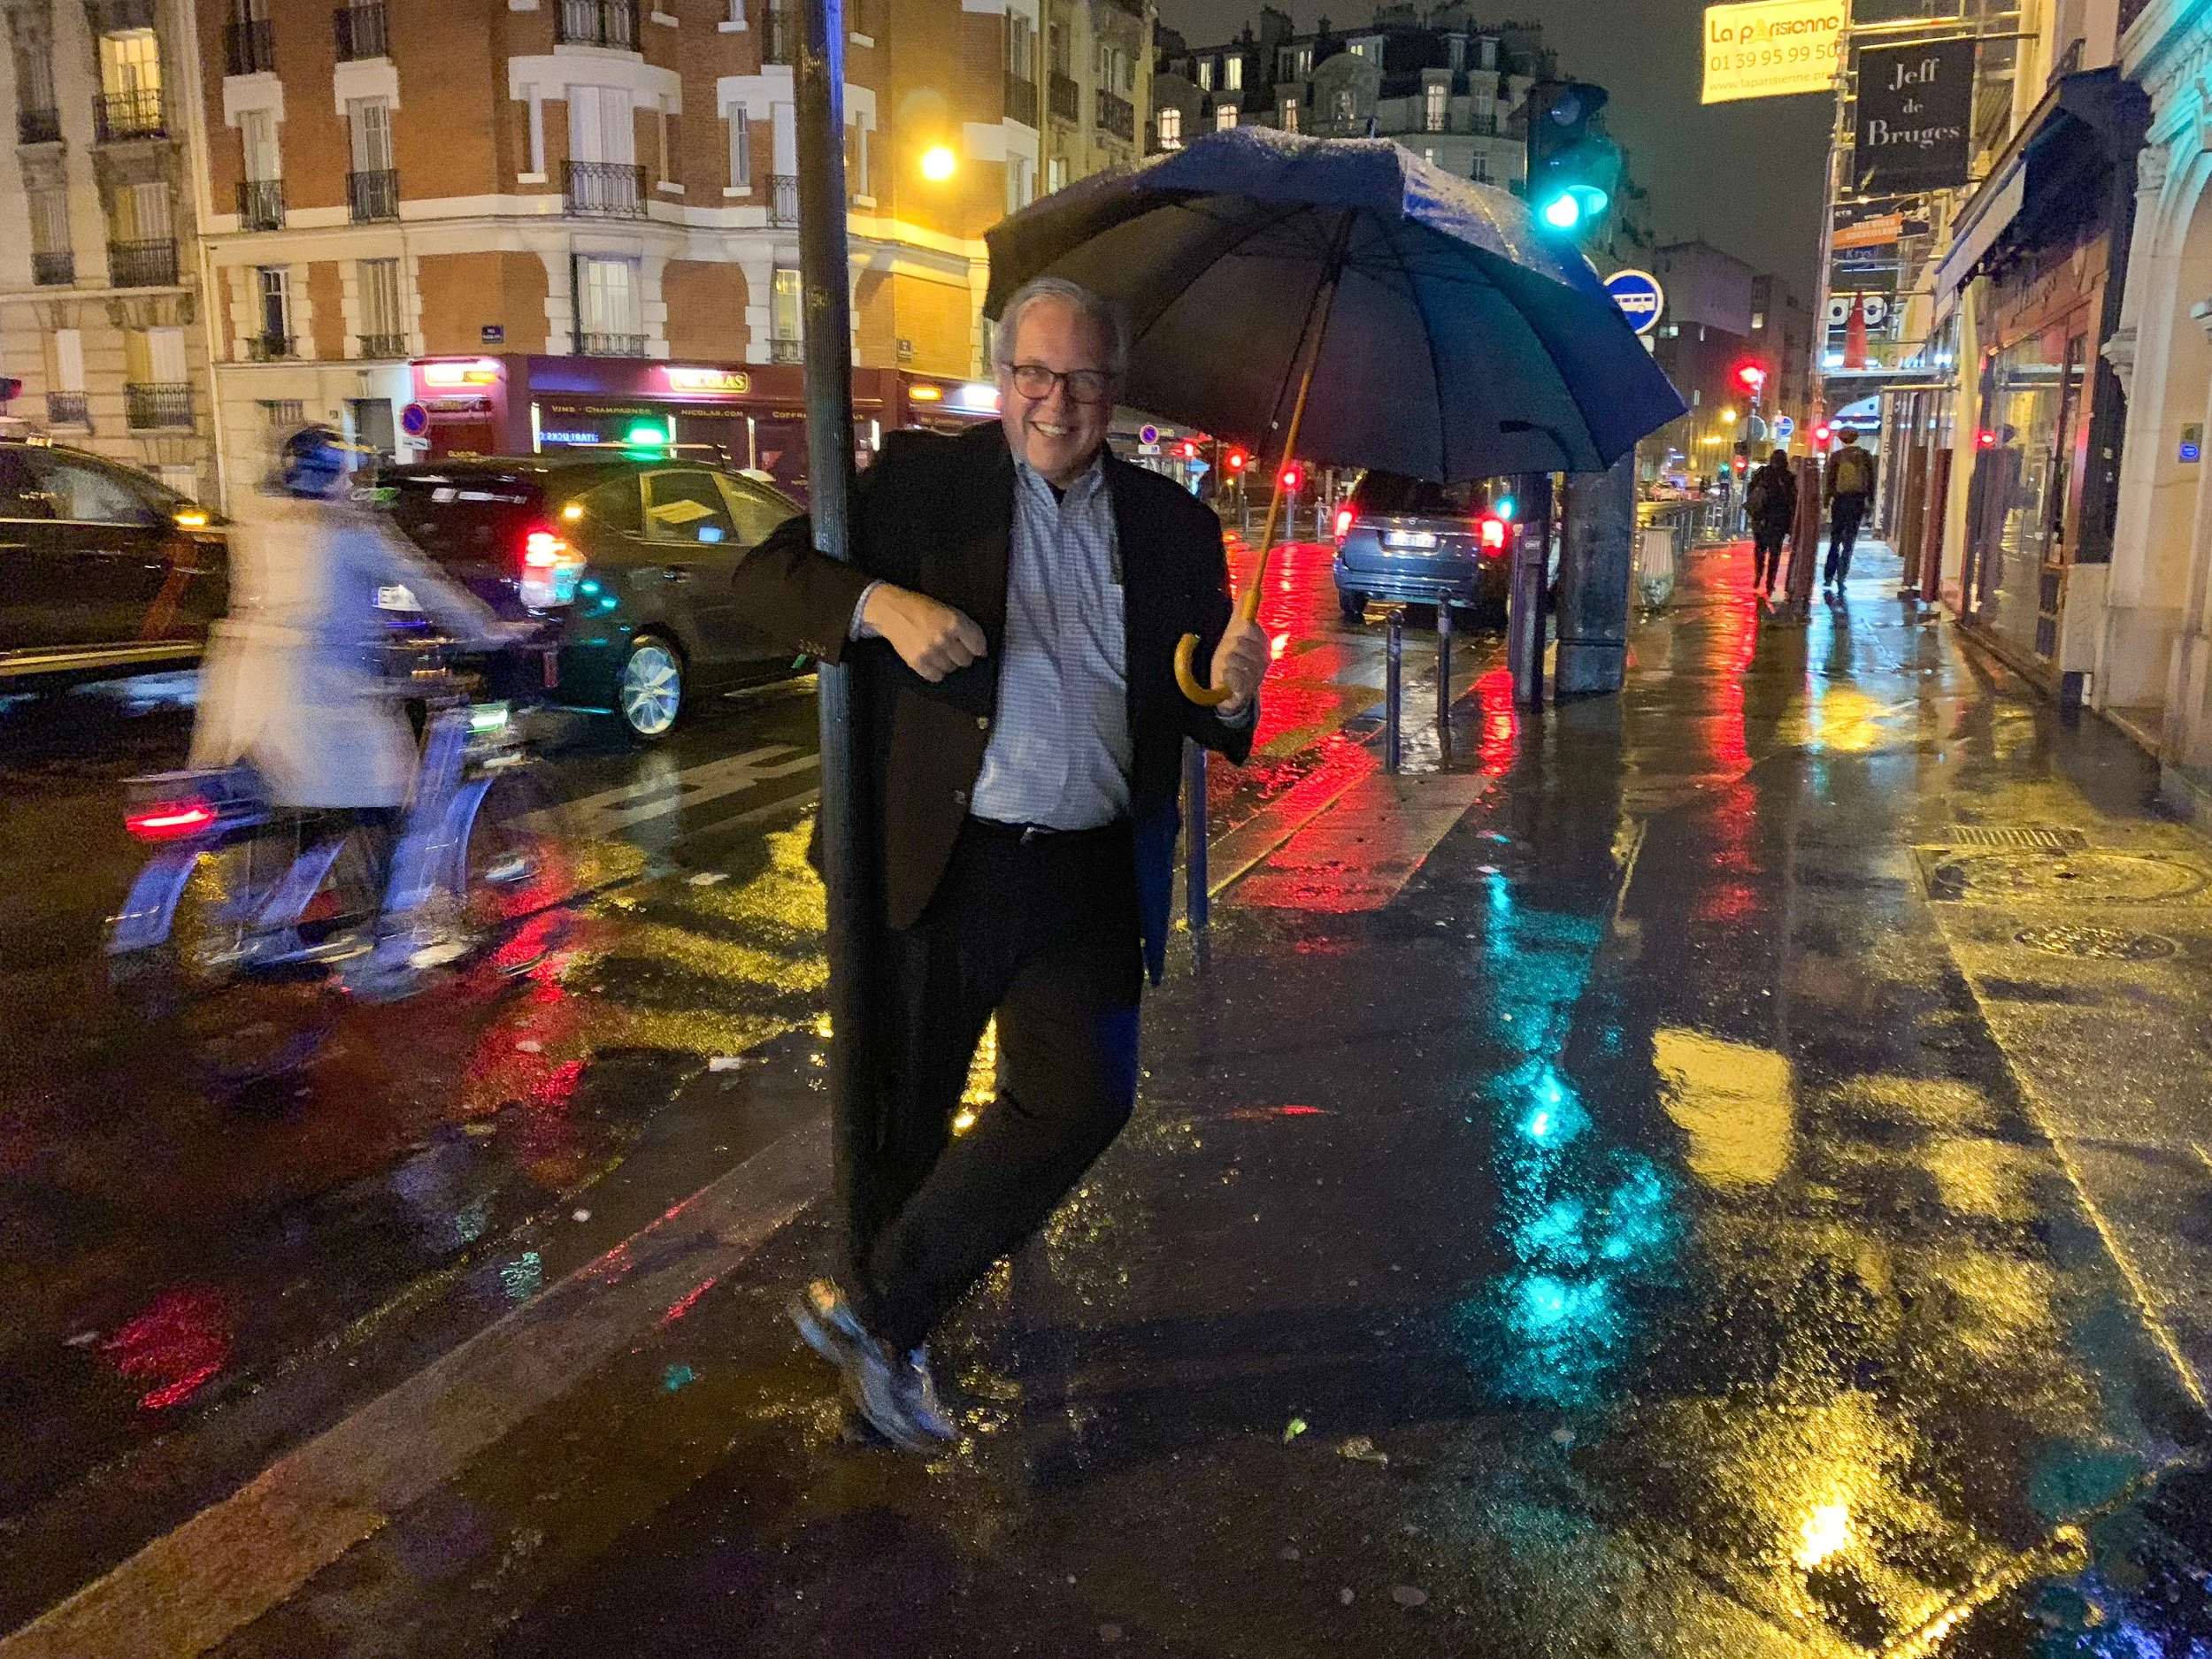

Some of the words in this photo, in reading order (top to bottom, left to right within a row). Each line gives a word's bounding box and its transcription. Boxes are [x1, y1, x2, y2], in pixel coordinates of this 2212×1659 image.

[1711, 20, 1733, 43] La
[1710, 55, 1731, 72] 01
[1735, 52, 1756, 69] 39
[1761, 49, 1783, 66] 95
[1787, 46, 1810, 63] 99
[1816, 42, 1837, 59] 50
[1888, 58, 1940, 91] Jeff
[1902, 98, 1924, 113] de
[1868, 119, 1962, 150] Bruges
